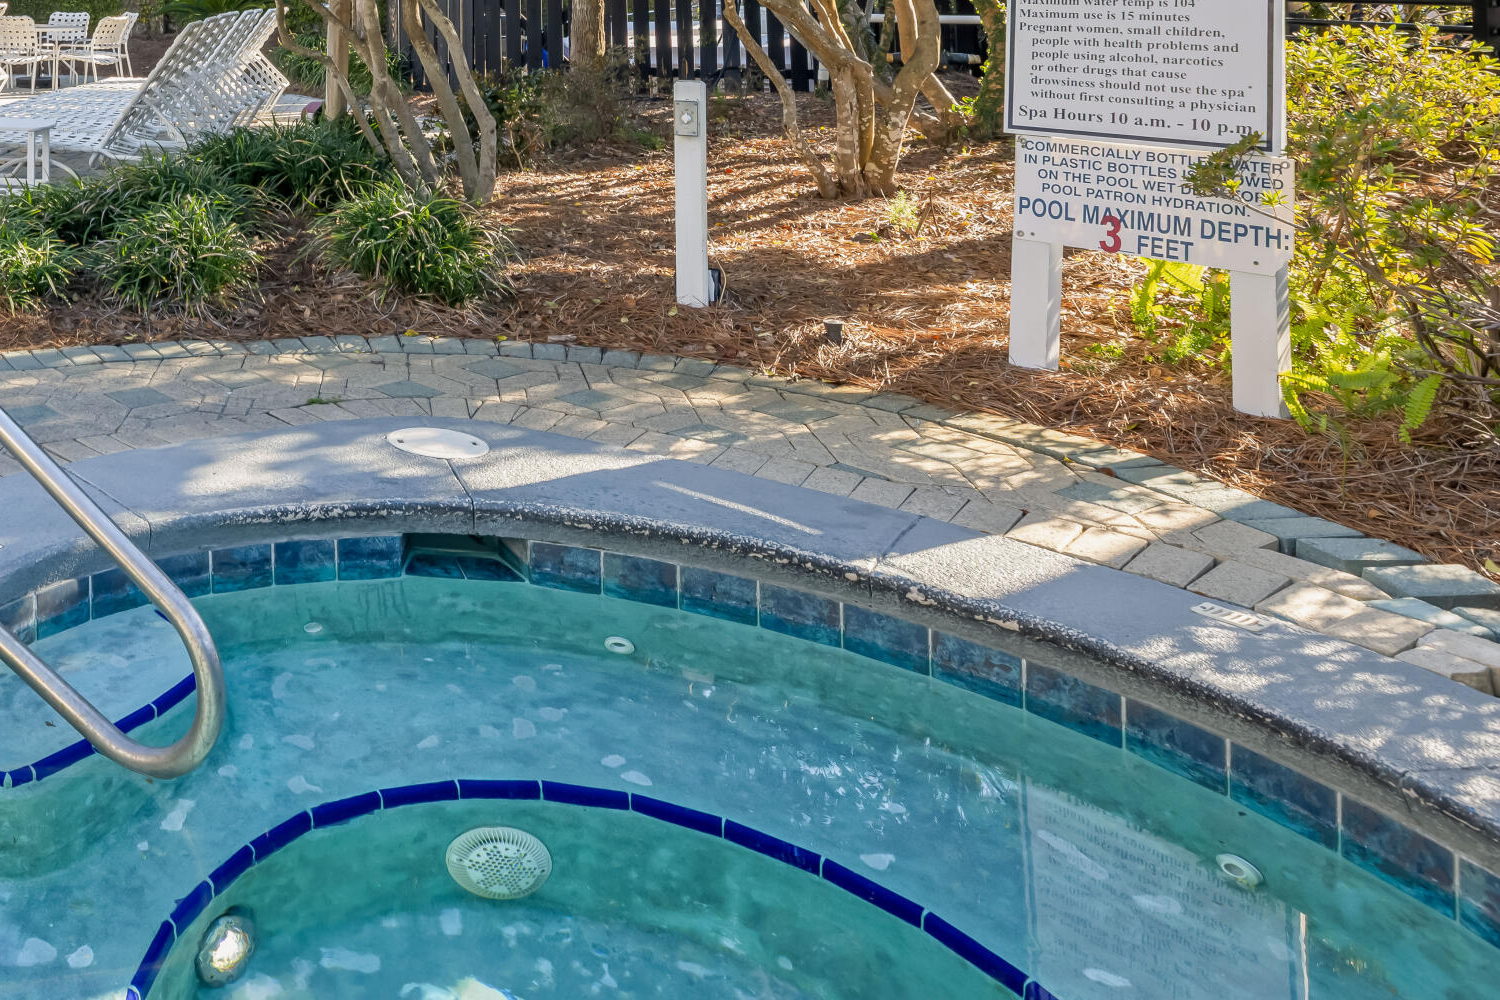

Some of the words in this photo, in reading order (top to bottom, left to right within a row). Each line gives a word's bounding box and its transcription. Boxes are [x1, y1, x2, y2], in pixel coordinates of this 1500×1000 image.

[1020, 9, 1079, 19] Maximum
[1083, 12, 1103, 20] use
[1107, 11, 1116, 20] is
[1121, 12, 1134, 21] 15
[1139, 12, 1190, 22] minutes
[1019, 22, 1072, 34] Pregnant
[1076, 25, 1123, 35] women,
[1127, 26, 1161, 35] small
[1165, 27, 1225, 39] children,
[1032, 38, 1069, 47] people
[1074, 38, 1099, 47] with
[1104, 39, 1142, 49] health
[1147, 42, 1209, 51] problems
[1213, 43, 1239, 53] and
[1032, 50, 1069, 60] people
[1074, 53, 1105, 63] using
[1109, 53, 1158, 64] alcohol,
[1163, 56, 1224, 66] narcotics
[1047, 64, 1078, 73] other
[1083, 65, 1117, 76] drugs
[1122, 67, 1146, 77] that
[1151, 70, 1187, 79] cause
[1031, 76, 1095, 88] drowsiness
[1099, 80, 1140, 91] should
[1145, 84, 1166, 92] not
[1196, 86, 1217, 96] the
[1221, 89, 1245, 99] spa
[1031, 90, 1075, 100] without
[1080, 92, 1104, 102] first
[1108, 94, 1174, 109] consulting
[1191, 101, 1256, 112] physician
[1018, 105, 1047, 120] Spa
[1053, 108, 1103, 123] Hours
[1109, 112, 1128, 124] 10
[1134, 117, 1171, 128] a.m.
[1192, 118, 1210, 131] 10
[1217, 123, 1254, 136] p.m
[1025, 140, 1141, 161] COMMERCIALLY
[1146, 151, 1210, 169] BOTTLE
[1024, 154, 1038, 164] IN
[1043, 156, 1102, 171] PLASTIC
[1107, 163, 1177, 179] BOTTLES
[1038, 169, 1058, 179] ON
[1063, 171, 1091, 184] THE
[1097, 175, 1137, 189] POOL
[1143, 181, 1176, 193] WET
[1042, 183, 1081, 197] POOL
[1087, 188, 1146, 204] PATRON
[1152, 196, 1250, 217] HYDRATION.
[1019, 196, 1075, 221] POOL
[1083, 204, 1191, 237] MAXIMUM
[1201, 219, 1289, 251] DEPTH:
[1100, 216, 1121, 253] 3
[1138, 235, 1194, 261] FEET
